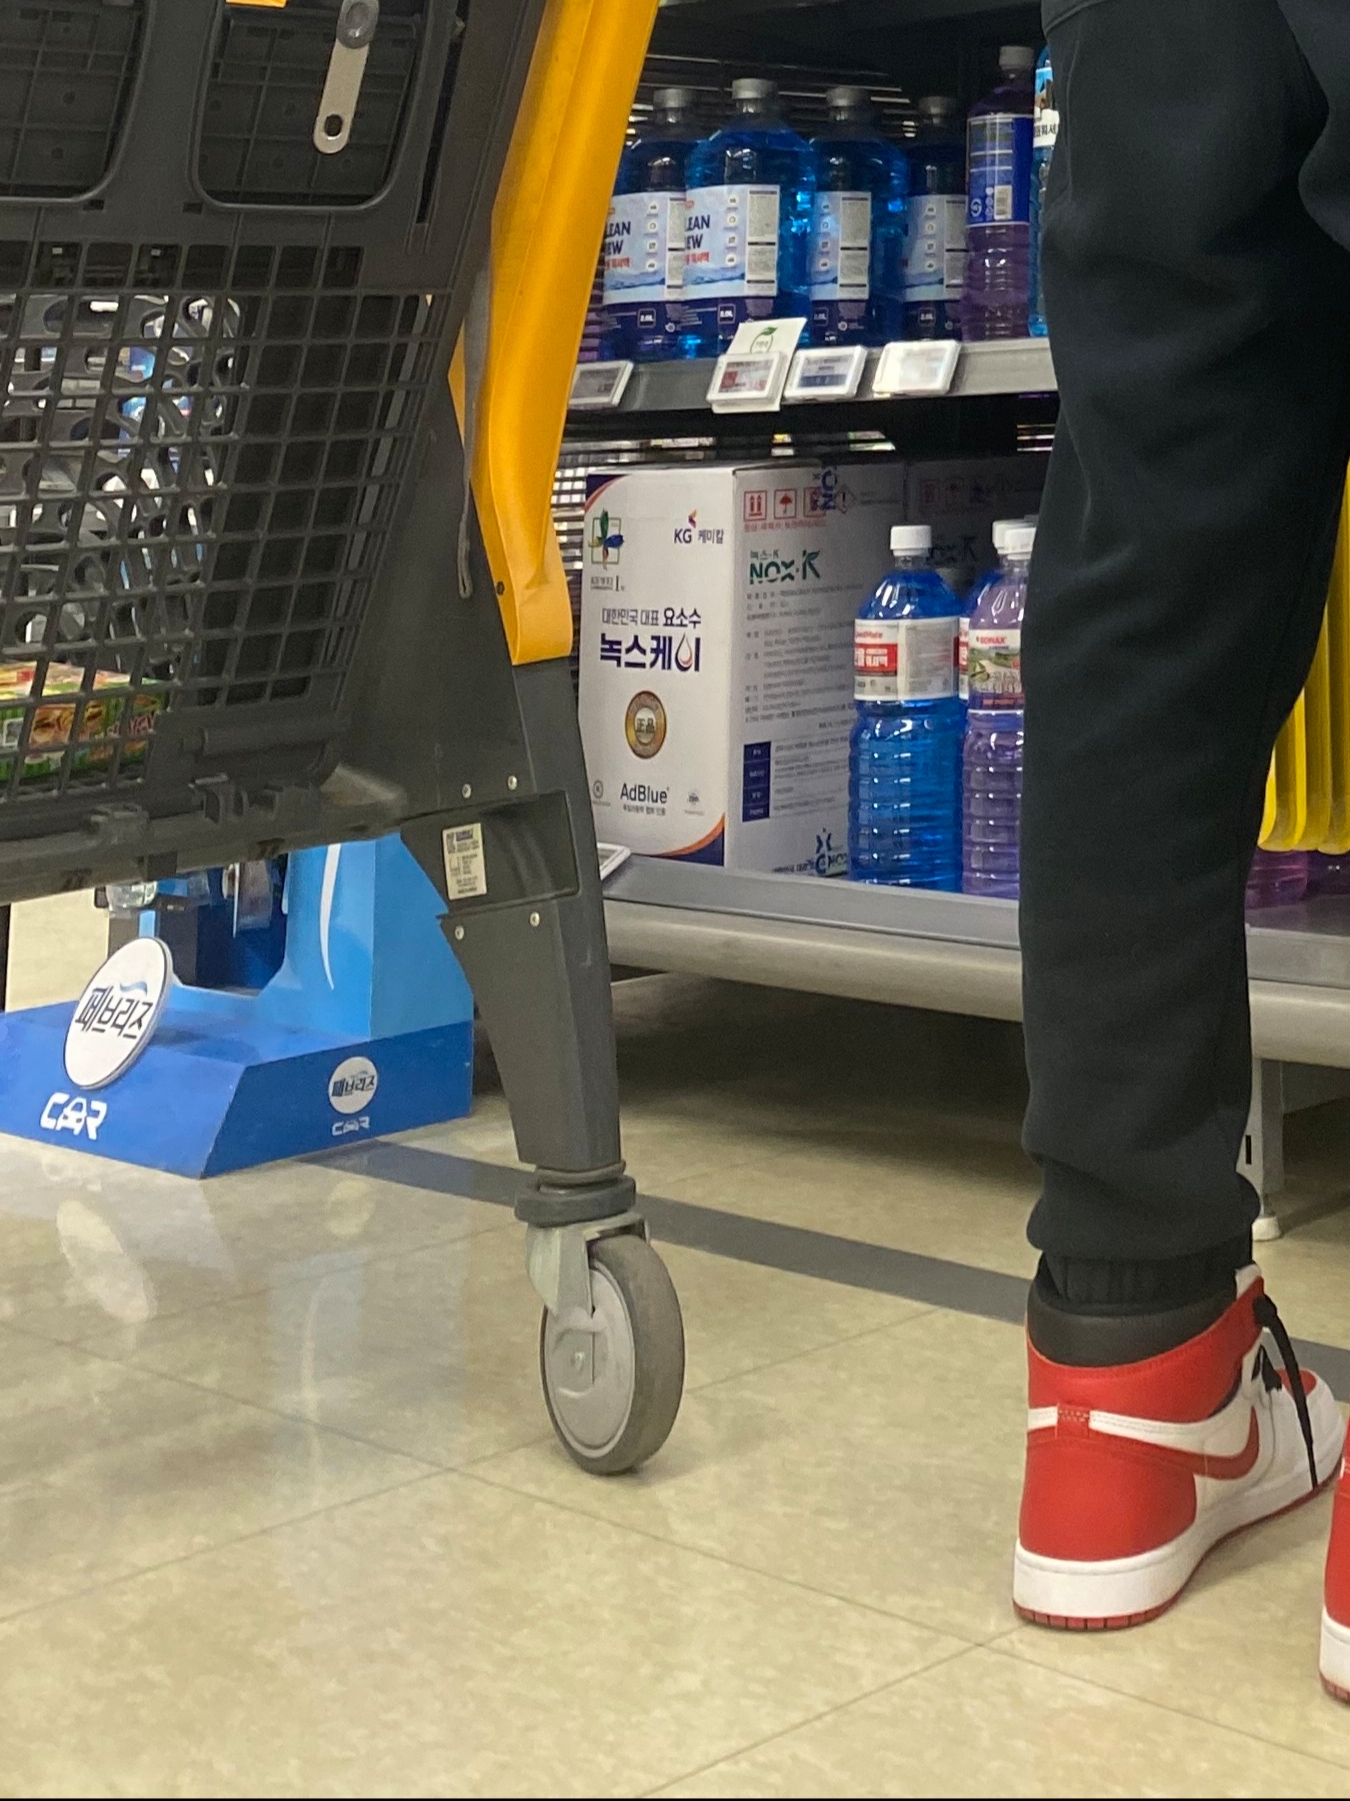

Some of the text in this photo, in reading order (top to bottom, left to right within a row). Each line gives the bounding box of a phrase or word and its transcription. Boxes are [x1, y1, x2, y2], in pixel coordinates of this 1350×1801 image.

[674, 528, 725, 544] KG 케미칼
[602, 607, 702, 629] 대한민국 대표 요소수
[600, 631, 701, 673] 녹스케이
[620, 782, 668, 805] AdBlue
[75, 983, 154, 1041] 페브리즈
[331, 1073, 378, 1099] 페브리즈
[39, 1091, 108, 1140] CAR
[331, 1116, 371, 1137] CAR
